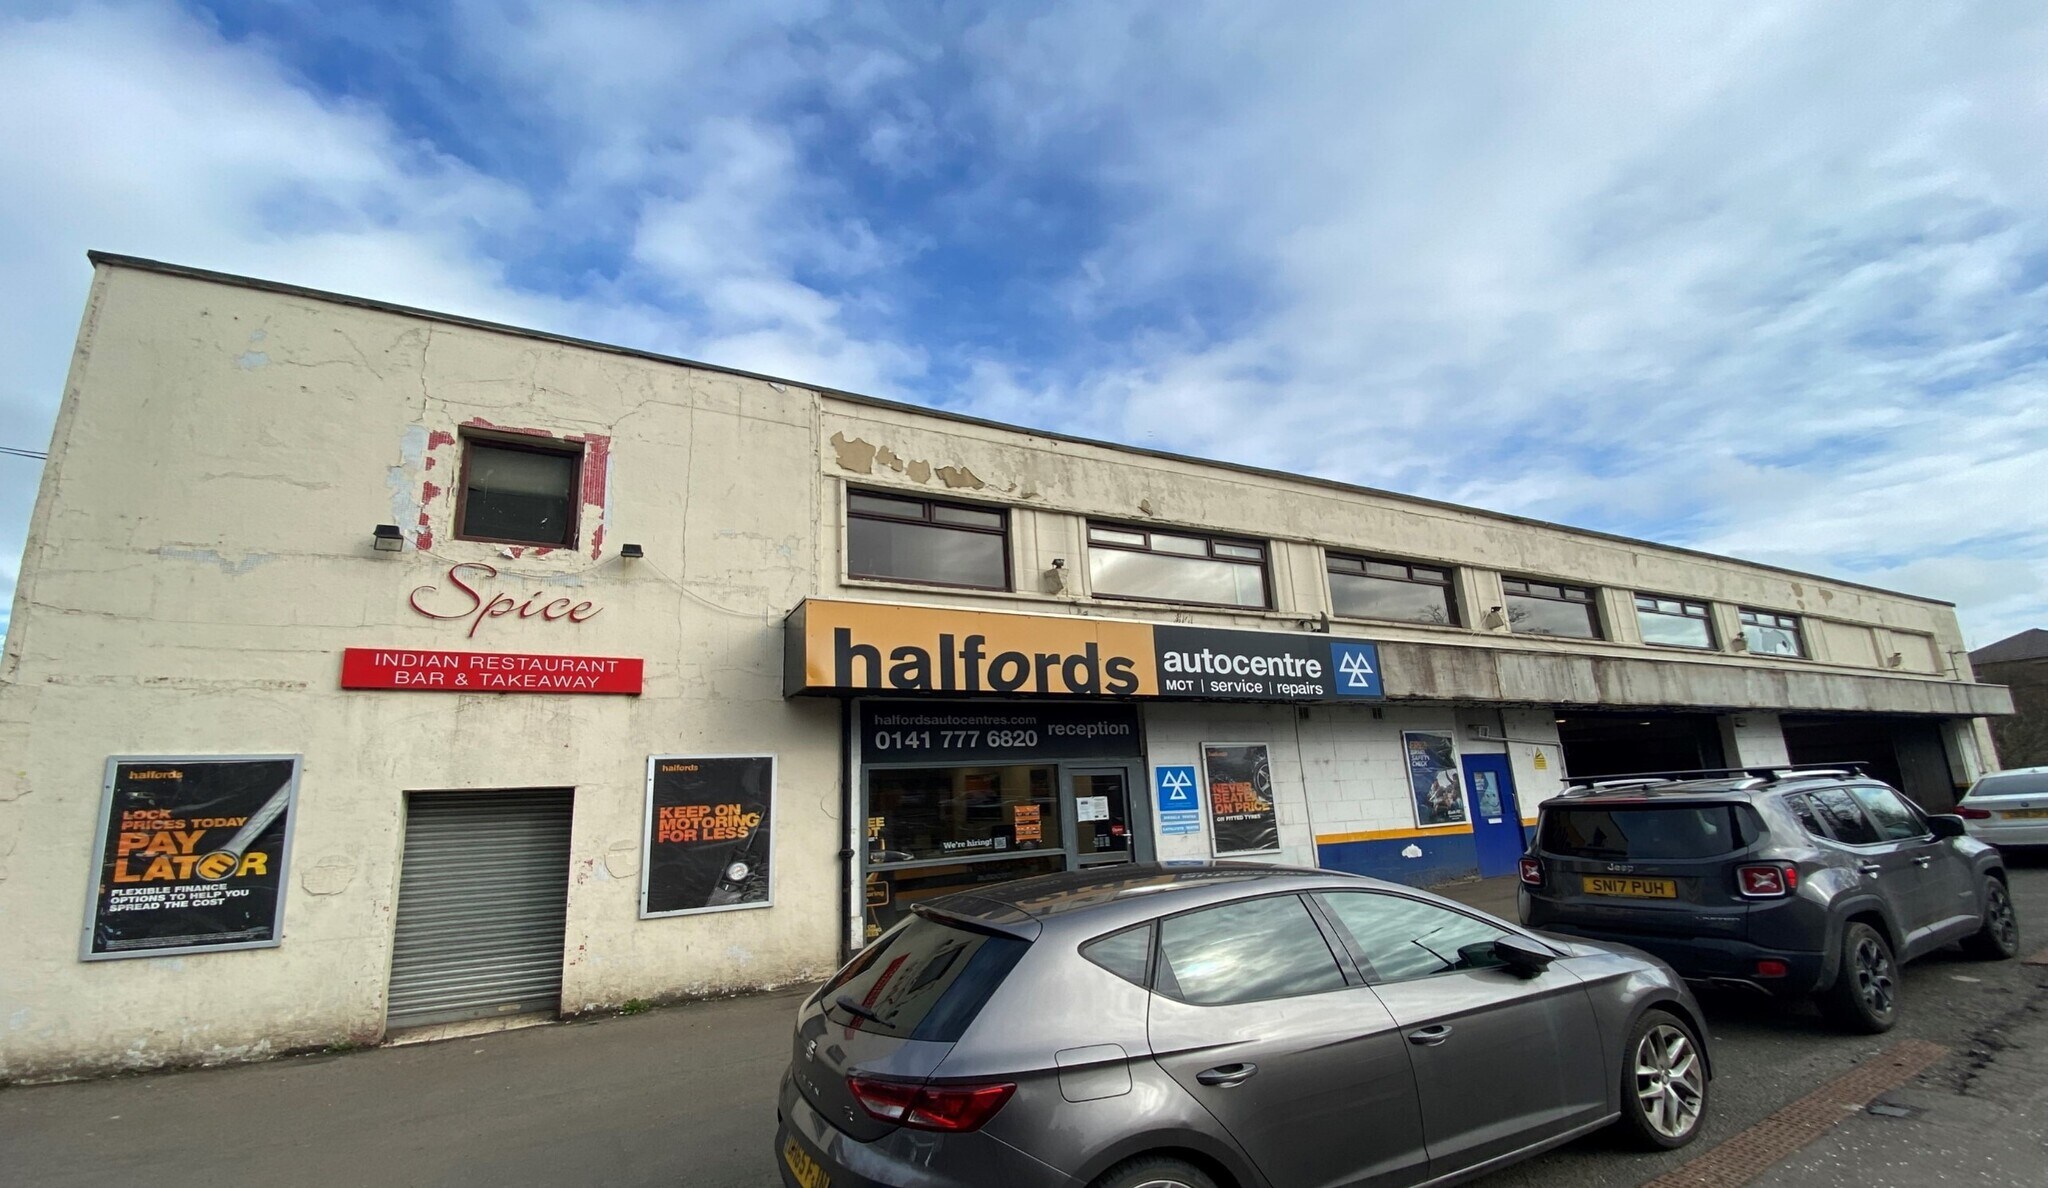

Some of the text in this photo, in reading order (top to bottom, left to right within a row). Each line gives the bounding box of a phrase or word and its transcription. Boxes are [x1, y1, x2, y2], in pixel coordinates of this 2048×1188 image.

[409, 562, 604, 639] Spice
[375, 653, 619, 673] INDIAN RESTAURANT
[834, 627, 1140, 695] halfords
[1163, 648, 1322, 678] autocentre
[394, 671, 601, 689] BAR & TAKEAWAY
[1166, 679, 1324, 697] MOT service repairs
[874, 714, 1037, 727] halfordsautocentres.com
[1047, 721, 1130, 739] reception
[875, 729, 1038, 750] 0141 777 6820
[129, 770, 183, 780] halfords
[662, 764, 699, 772] halfords
[1212, 782, 1252, 793] NEVER
[123, 809, 172, 820] LOCK
[659, 804, 742, 819] KEEP ON
[1215, 801, 1270, 814] ON PRICE
[121, 817, 248, 831] PRICES TODAY
[659, 812, 761, 831] MOTORING
[658, 826, 750, 843] FOR LESS
[117, 830, 206, 857] PAY
[943, 838, 992, 849] We're hiring!
[113, 851, 268, 883] LATER
[1607, 863, 1634, 873] Jeep
[111, 884, 227, 897] FLEXIBLE FINANCE
[1593, 879, 1627, 892] SN17
[1631, 881, 1665, 895] PUH
[109, 898, 225, 912] SPREAD THE COST
[110, 889, 250, 905] OPTIONS TO HELP YOU
